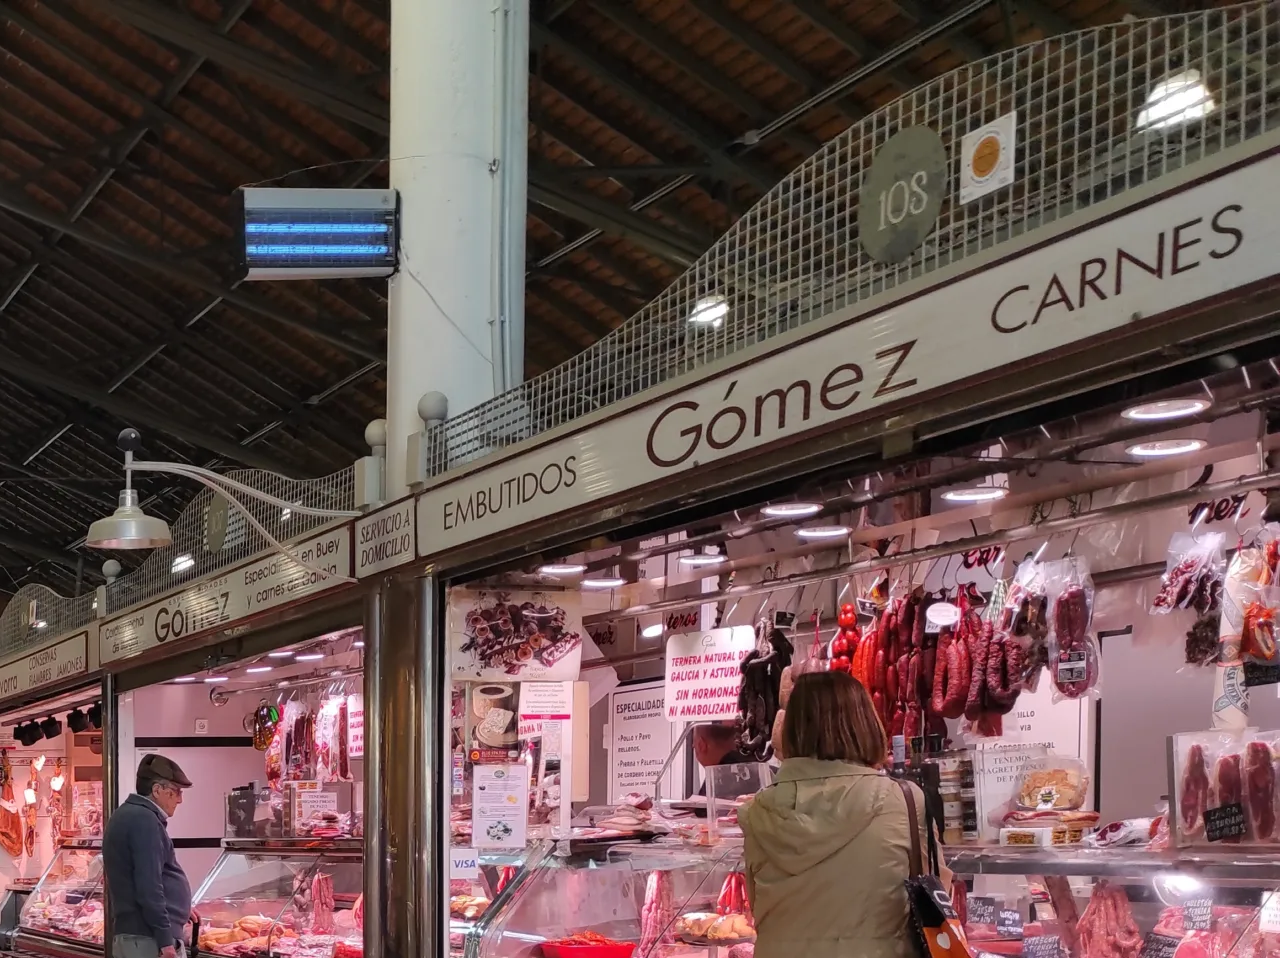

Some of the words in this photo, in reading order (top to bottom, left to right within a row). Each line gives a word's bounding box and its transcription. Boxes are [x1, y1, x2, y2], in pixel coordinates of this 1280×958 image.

[443, 455, 577, 531] EMBUTIDOS
[646, 339, 918, 467] Gómez
[991, 205, 1244, 333] CARNES
[360, 515, 402, 545] SERVICIO
[403, 509, 410, 526] A
[302, 549, 314, 563] en
[317, 539, 340, 559] Buey
[360, 533, 410, 568] DOMICILIO
[247, 596, 253, 609] y
[256, 583, 285, 603] carnes
[29, 648, 57, 670] CONSERVAS
[57, 656, 82, 678] JAMONES
[672, 655, 701, 667] TERNERA
[704, 651, 735, 663] NATURAL
[671, 669, 699, 682] GALICIA
[703, 669, 707, 679] Y
[710, 666, 741, 678] ASTURIA
[675, 688, 689, 700] SIN
[692, 685, 740, 699] HORMONAS
[616, 698, 665, 714] ESPECIALIDADE
[669, 705, 678, 716] NI
[993, 755, 1032, 764] TENEMOS
[453, 860, 476, 868] VISA
